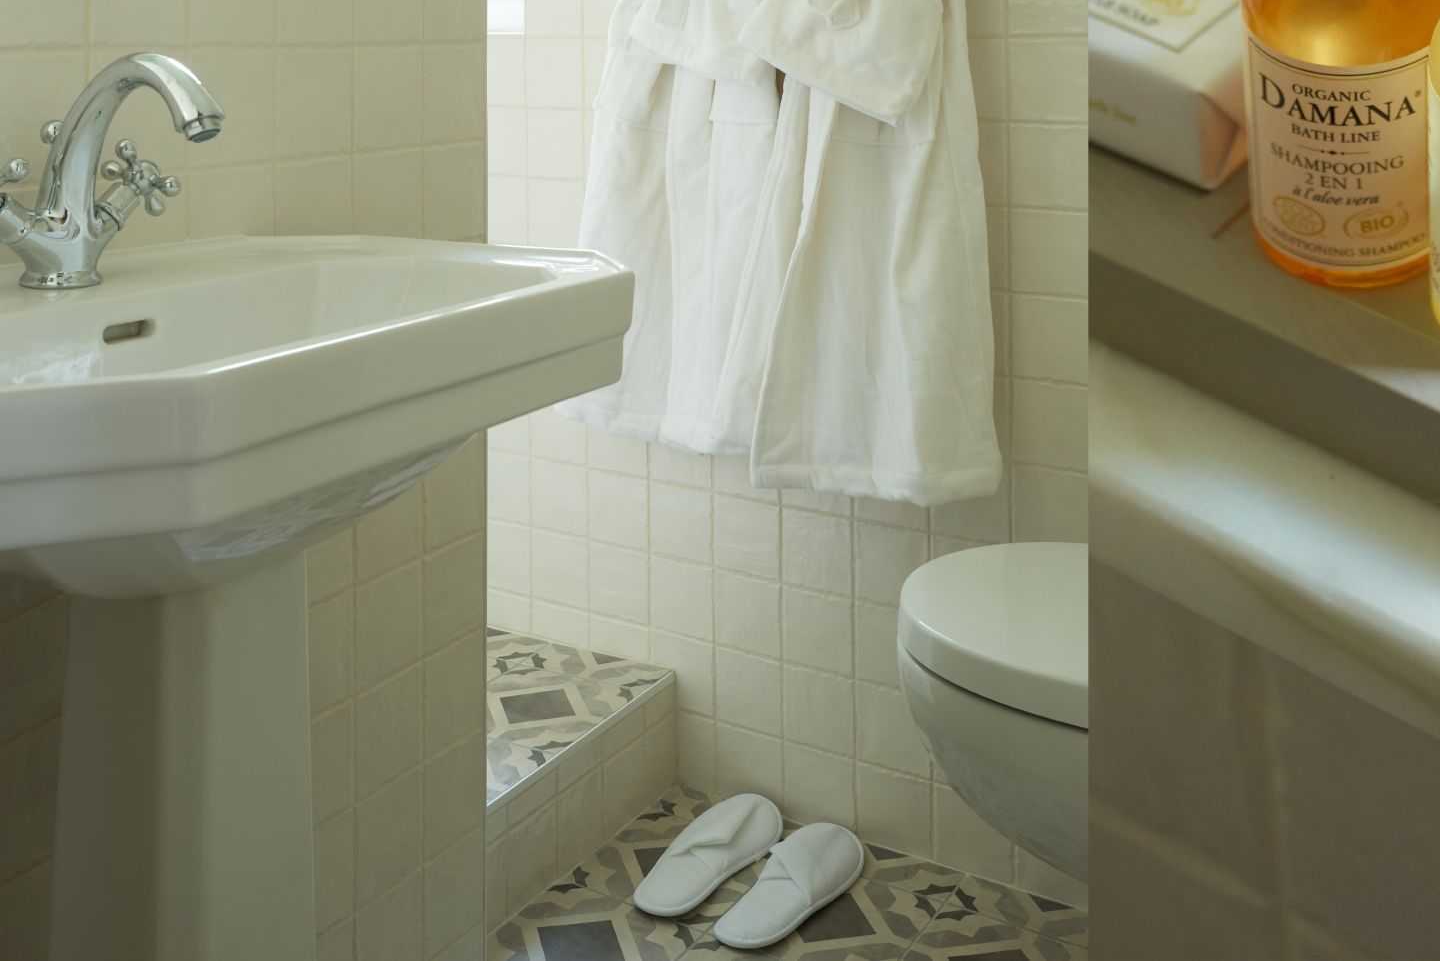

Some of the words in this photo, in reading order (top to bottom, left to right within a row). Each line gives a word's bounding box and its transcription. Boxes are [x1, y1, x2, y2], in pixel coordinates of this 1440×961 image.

[1259, 72, 1416, 127] DAMANA
[1292, 83, 1371, 102] ORGANIC
[1291, 123, 1335, 143] BATH
[1340, 130, 1381, 144] LINE
[1270, 142, 1404, 175] SHAMPOOING
[1304, 172, 1315, 186] 2
[1320, 175, 1348, 190] EN
[1355, 175, 1364, 190] 1
[1347, 193, 1381, 207] vera
[1359, 214, 1395, 235] BIO
